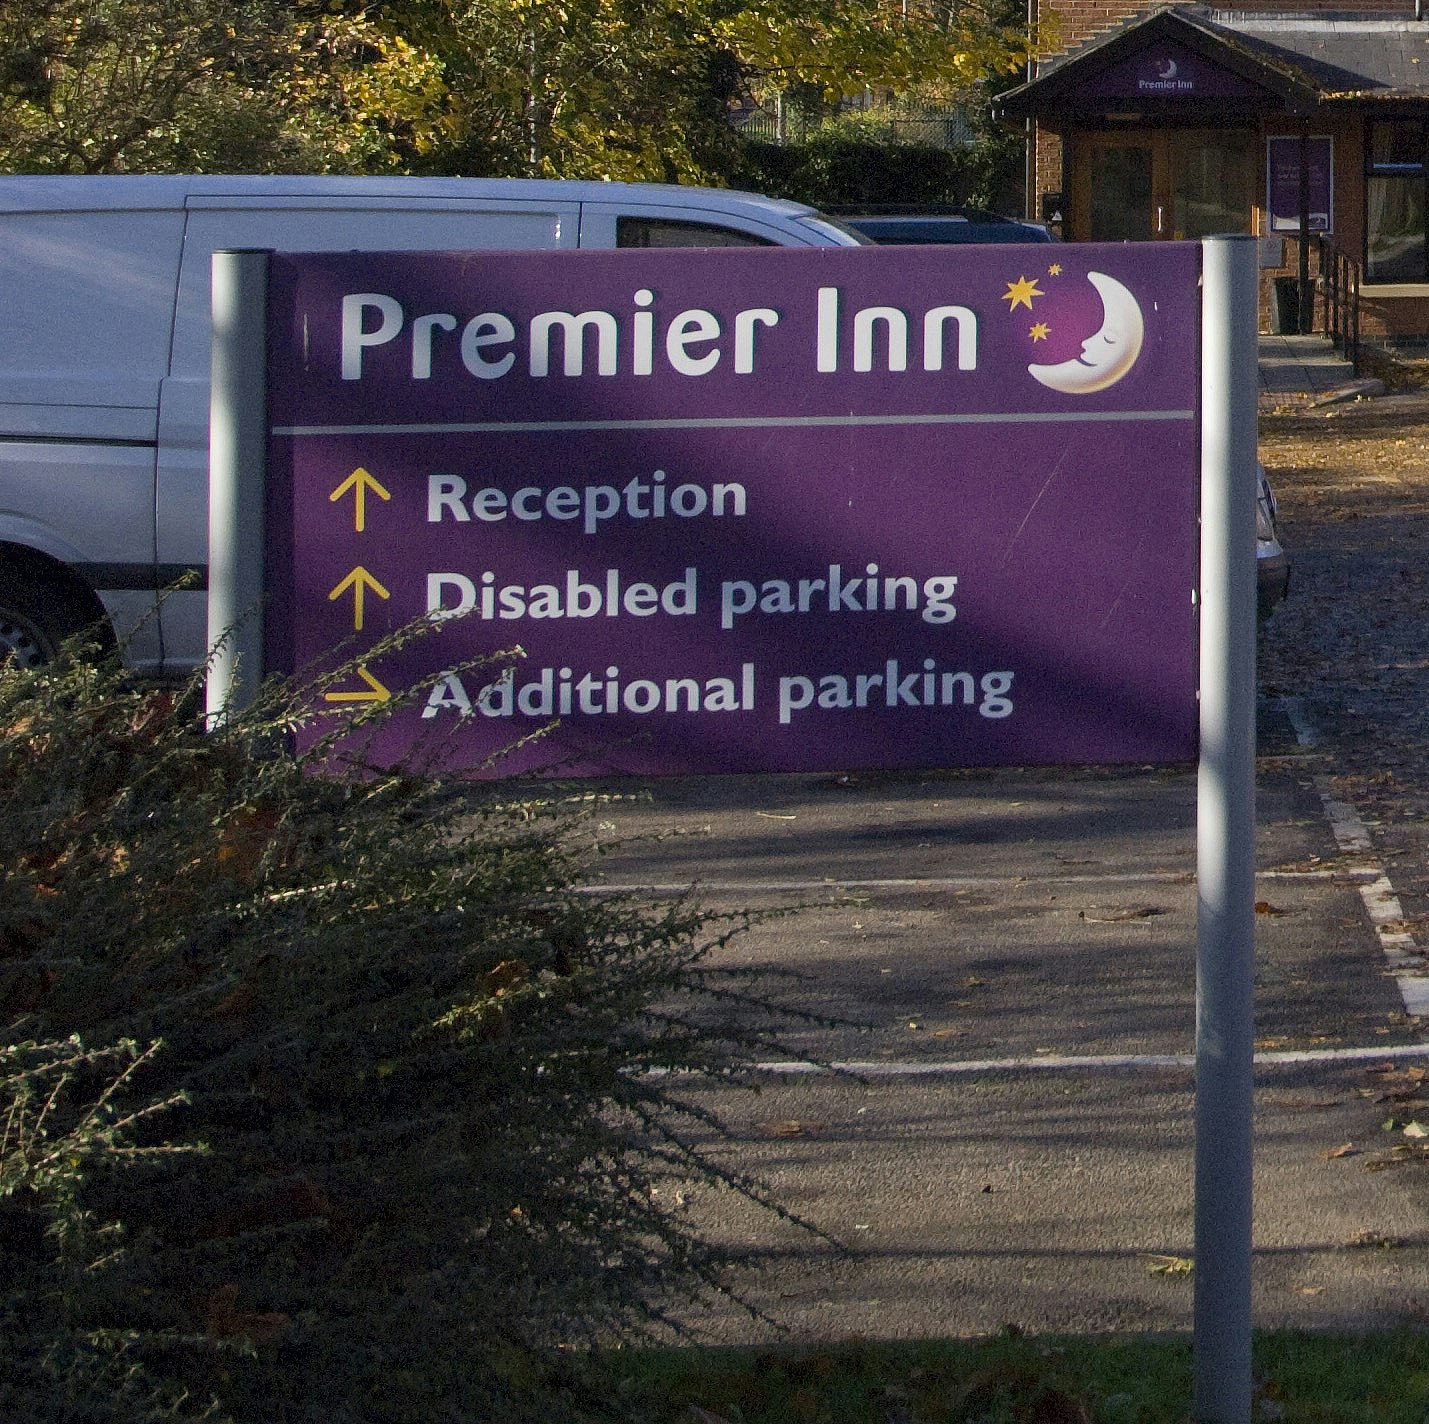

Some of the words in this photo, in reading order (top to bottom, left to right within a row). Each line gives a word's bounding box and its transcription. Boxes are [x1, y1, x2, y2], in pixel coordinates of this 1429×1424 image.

[1138, 79, 1177, 89] Premier
[1177, 79, 1193, 89] Inn
[341, 287, 779, 380] Premier
[816, 286, 978, 373] Inn
[427, 469, 748, 533] Reception
[425, 567, 698, 623] Disabled
[719, 562, 959, 630] parking
[421, 663, 755, 719] Additional
[777, 658, 1015, 723] parking
